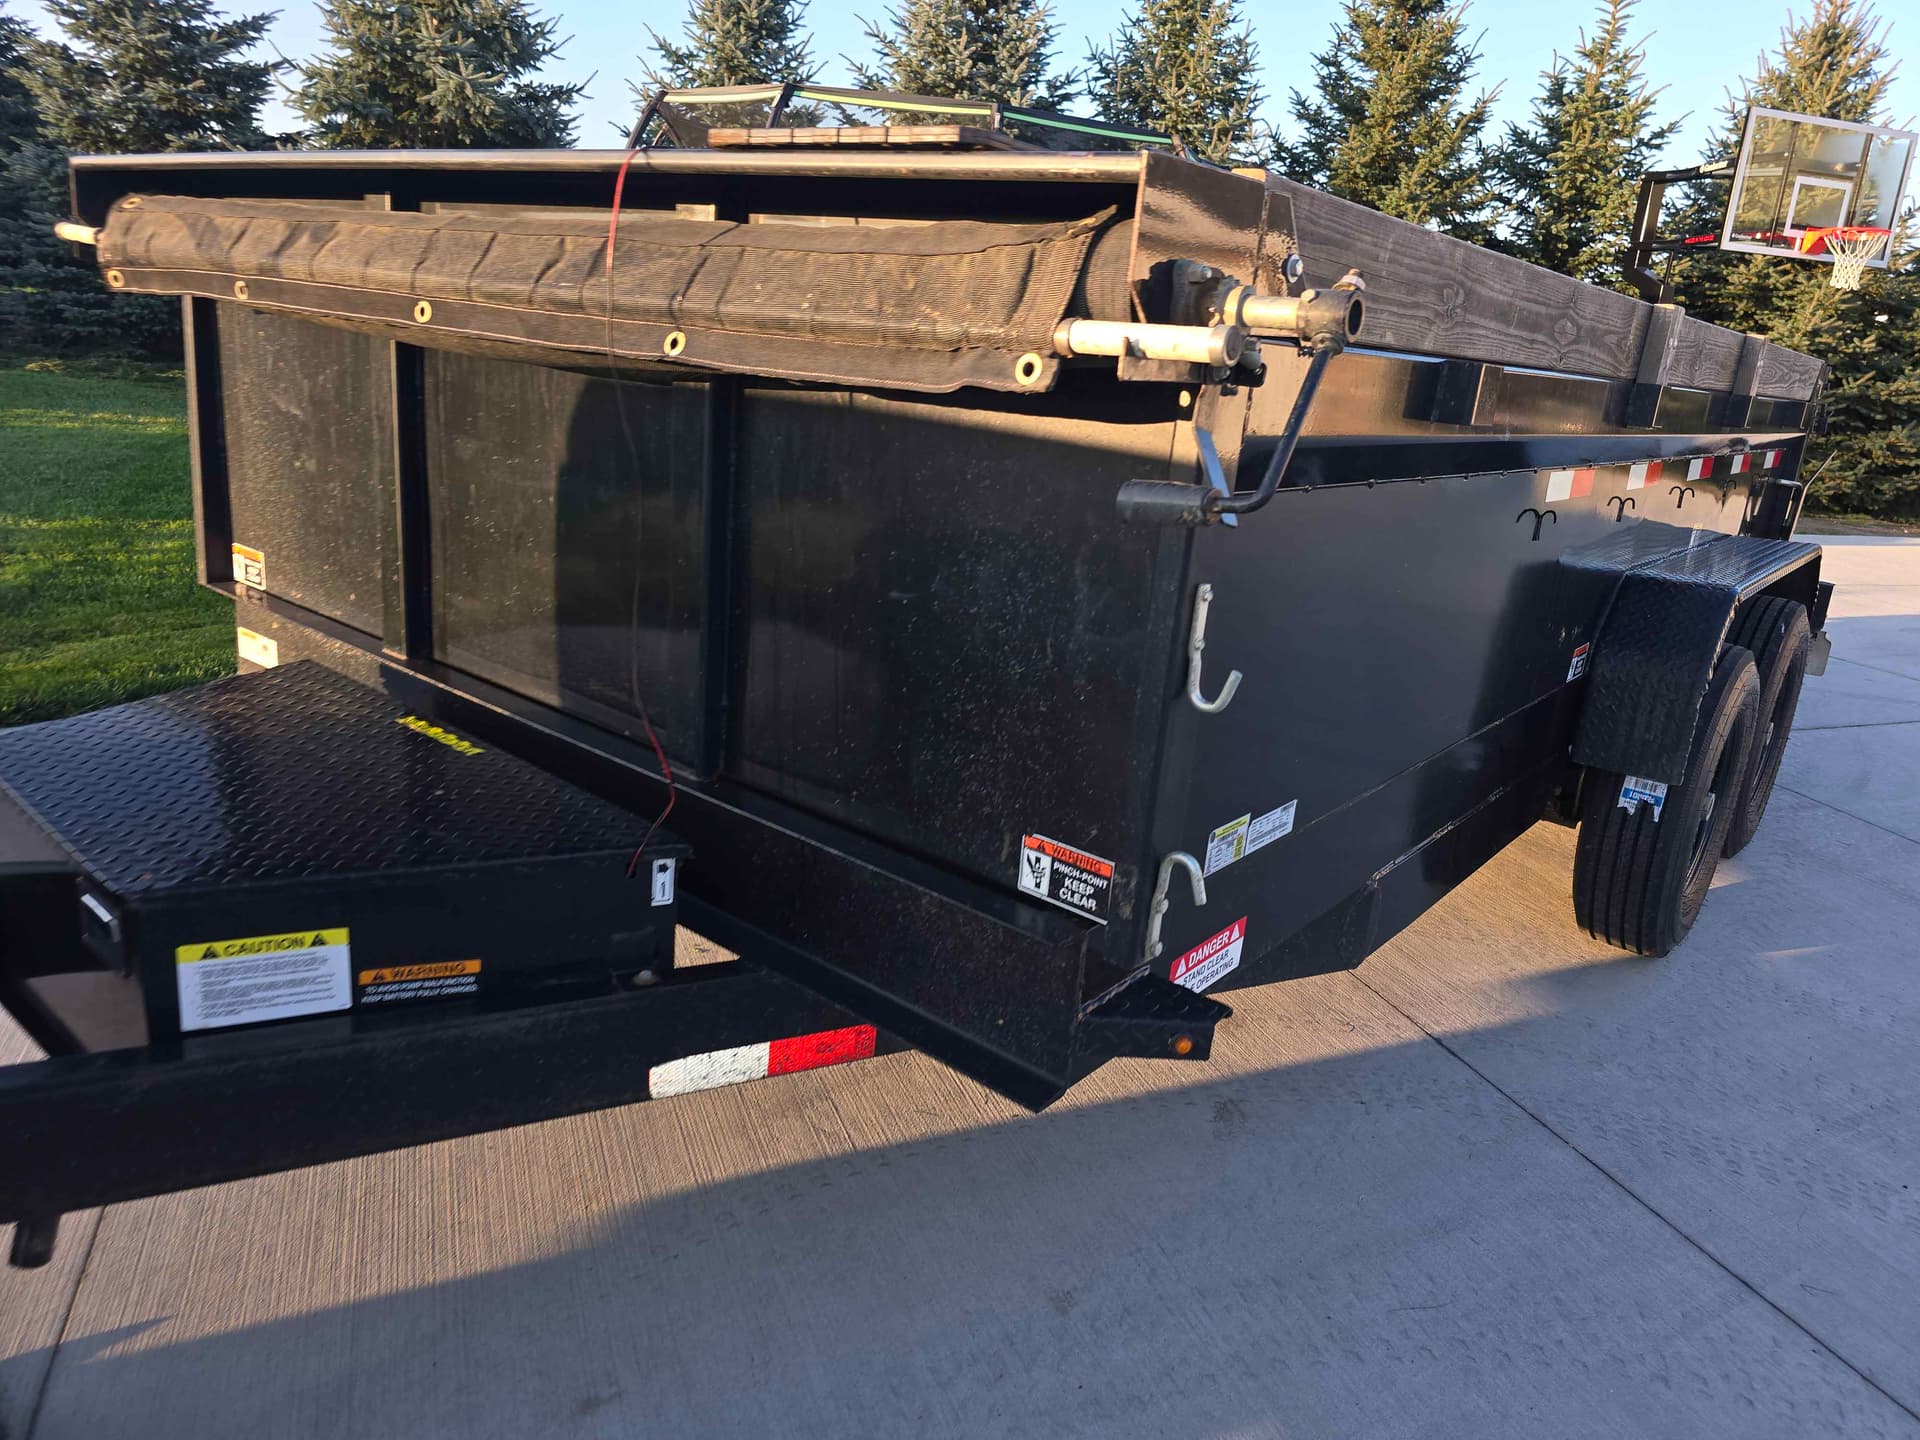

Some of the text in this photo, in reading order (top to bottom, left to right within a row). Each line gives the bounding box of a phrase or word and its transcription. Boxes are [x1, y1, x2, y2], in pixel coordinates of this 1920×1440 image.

[1053, 844, 1102, 872] WARNING
[1053, 861, 1109, 890] PINCH-POINT
[1064, 876, 1095, 897] KEEP
[1059, 887, 1097, 911] CLEAR
[223, 935, 306, 957] CAUTION
[1187, 930, 1230, 968] DANGER
[1183, 949, 1230, 985] STAND CLEAR
[1196, 957, 1234, 989] OPERATING
